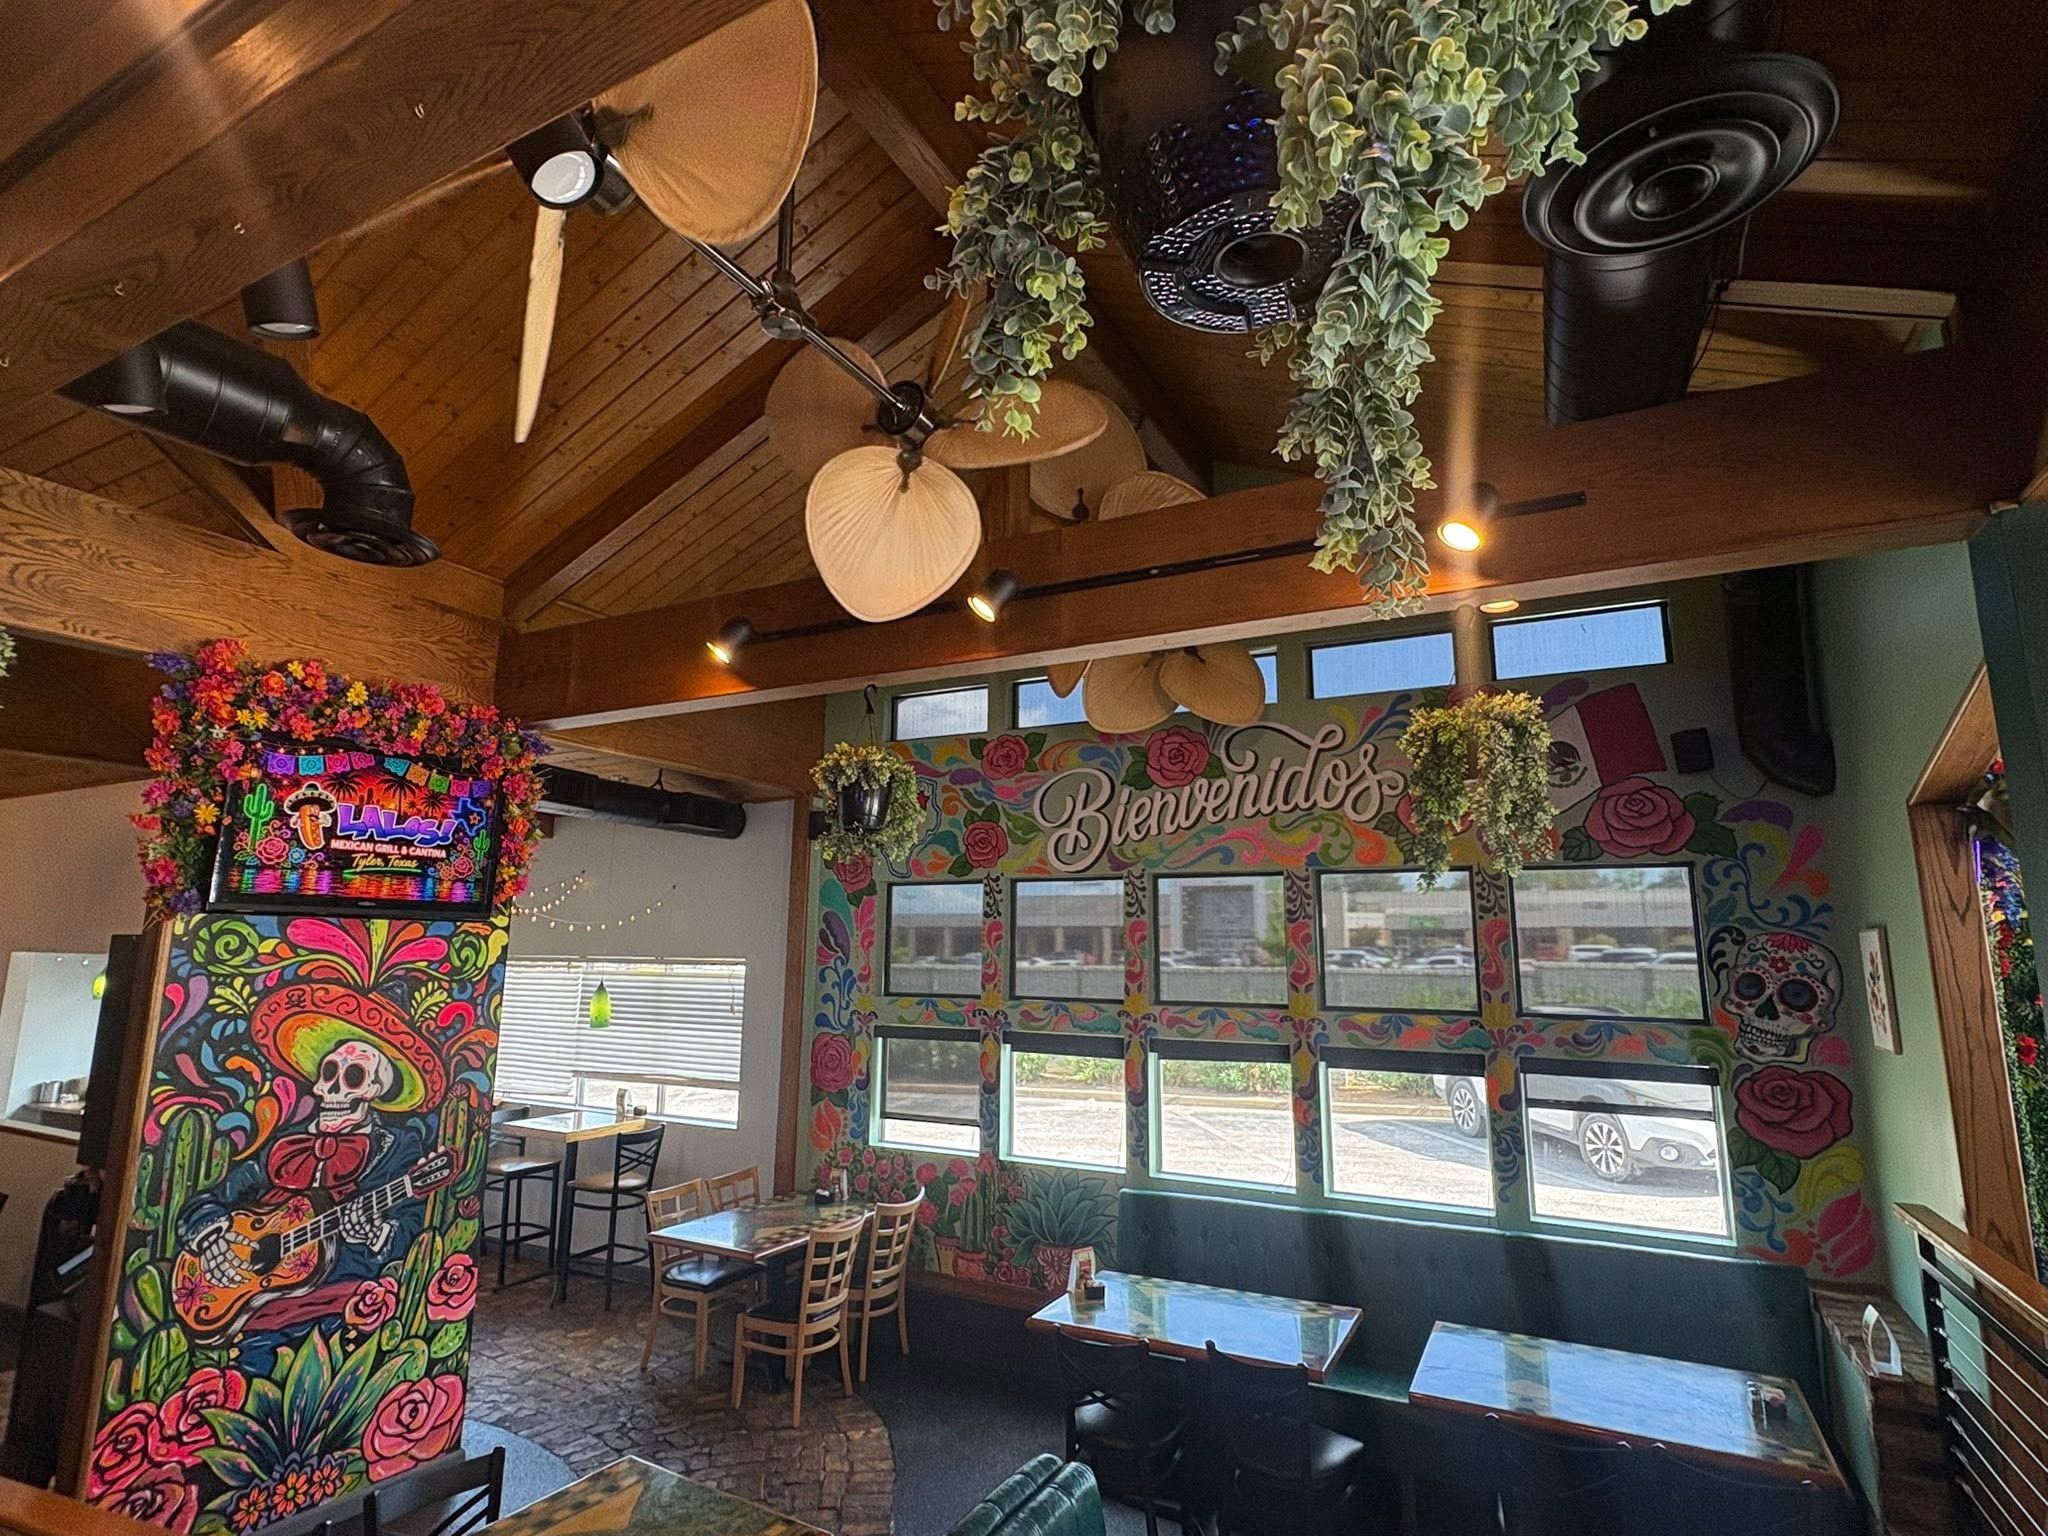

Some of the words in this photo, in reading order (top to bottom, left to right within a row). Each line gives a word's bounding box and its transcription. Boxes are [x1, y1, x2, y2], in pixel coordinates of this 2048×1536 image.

[1034, 722, 1406, 872] Bienvenidos
[337, 802, 458, 847] LALOS!
[330, 839, 374, 852] MEXICAN
[375, 844, 400, 854] GRILL
[408, 847, 447, 859] CANTINA
[352, 853, 385, 872] Tyler,
[387, 855, 418, 868] Texas
